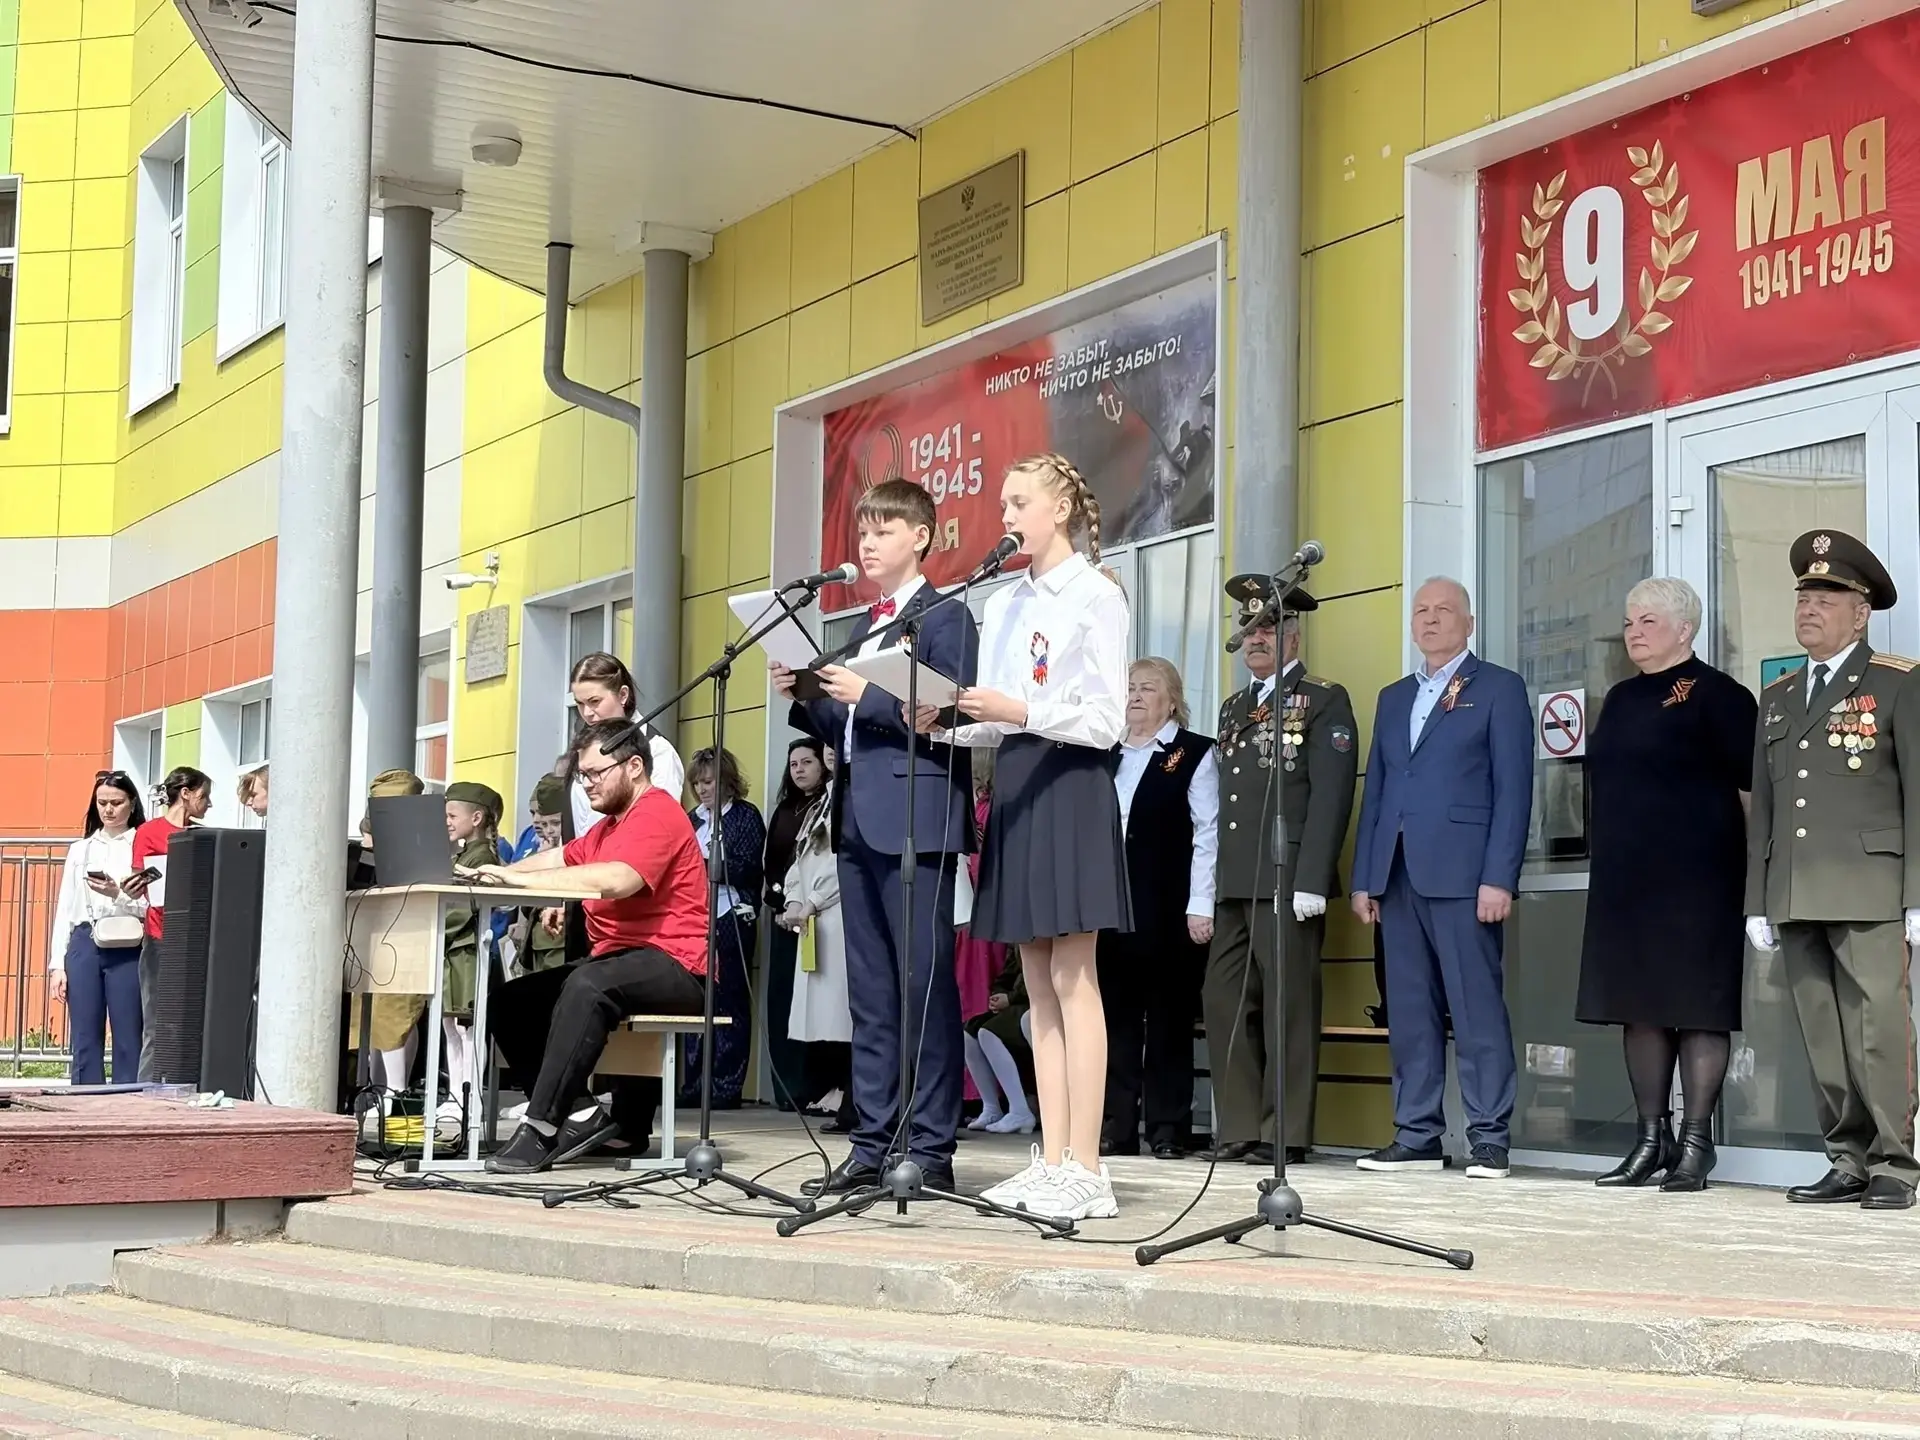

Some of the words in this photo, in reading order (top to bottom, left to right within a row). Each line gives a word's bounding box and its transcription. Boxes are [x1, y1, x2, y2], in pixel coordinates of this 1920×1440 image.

[1562, 185, 1624, 340] 9
[1736, 116, 1886, 252] МАЯ
[1738, 220, 1894, 309] 1941-1945
[985, 365, 1030, 395] НИКТО
[1034, 358, 1054, 379] НЕ
[1057, 339, 1109, 371] ЗАБЫТ,
[1039, 368, 1087, 400] НИЧТО
[1091, 360, 1111, 382] НЕ
[1114, 335, 1181, 375] ЗАБЫТО!
[909, 422, 961, 472] 1941
[927, 517, 960, 556] АЯ
